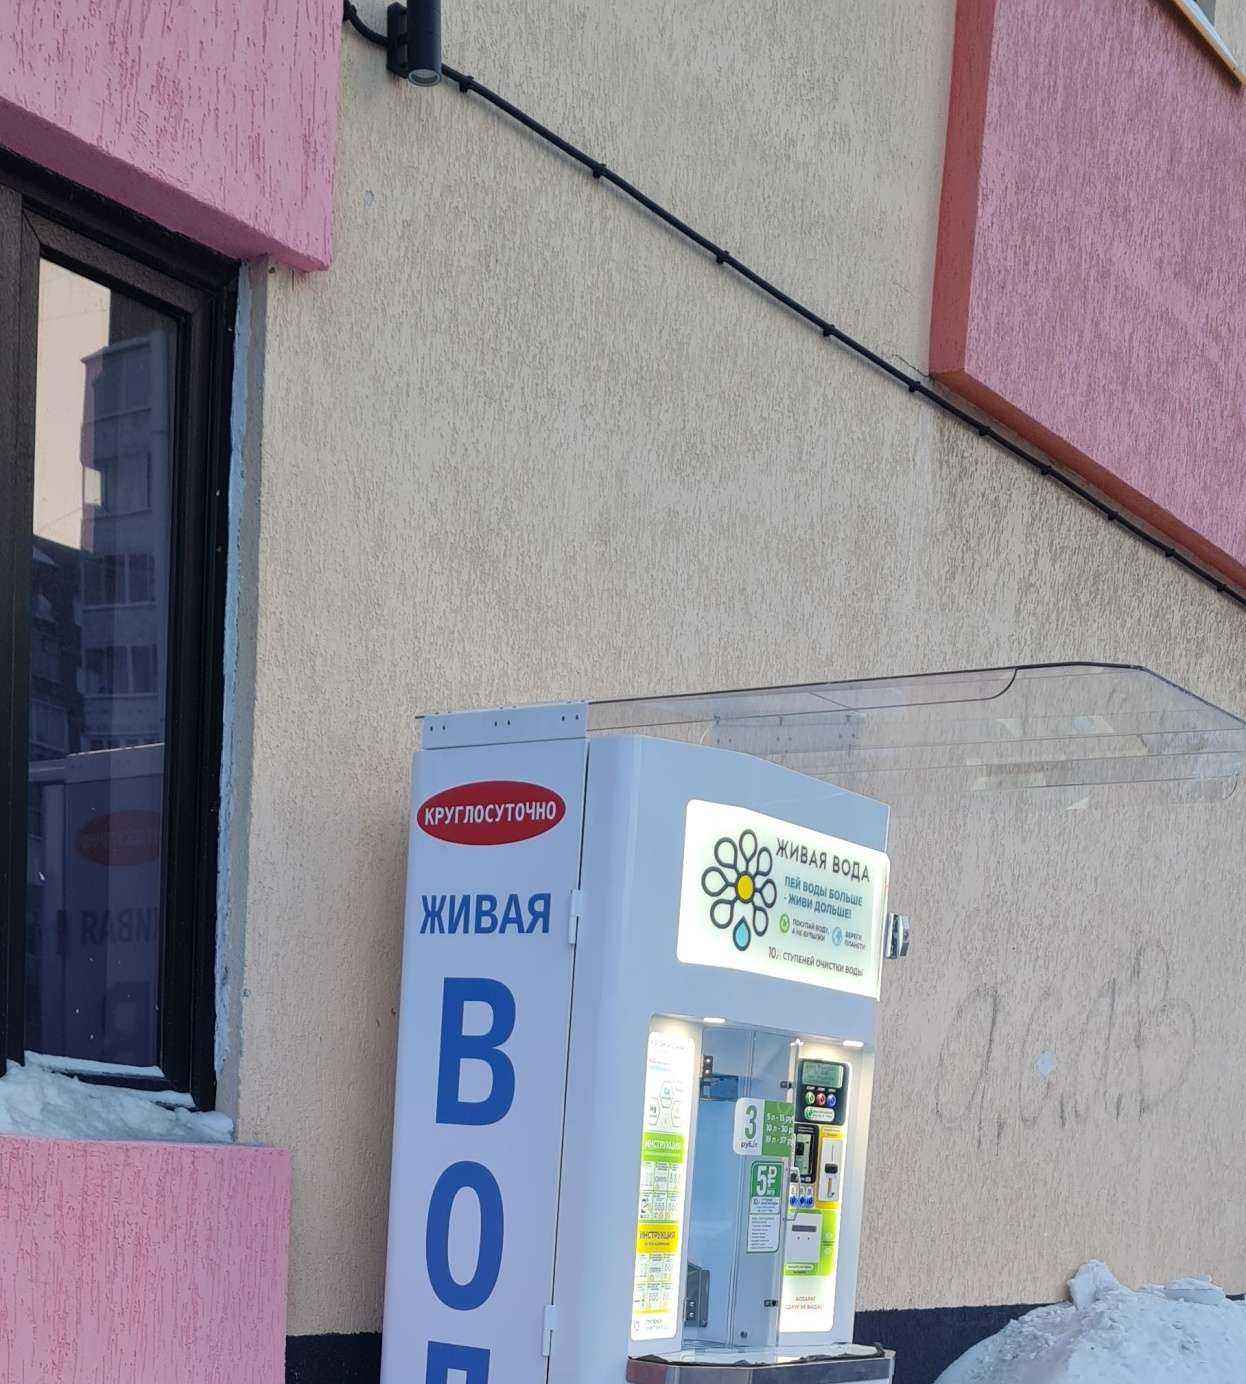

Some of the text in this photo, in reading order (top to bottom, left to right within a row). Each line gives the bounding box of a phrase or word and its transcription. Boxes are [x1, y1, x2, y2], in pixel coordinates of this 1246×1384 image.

[424, 801, 557, 826] КРУГЛОСУТОЧНО
[776, 838, 870, 883] ЖИВАЯ ВОДА
[785, 875, 863, 906] ПЕЙ ВОДЫ БОЛЬШЕ
[788, 893, 813, 909] ЖИВИ
[814, 898, 852, 918] ДОЛЬШЕ!
[419, 892, 552, 935] ЖИВАЯ
[782, 951, 815, 967] СТУПЕНЕЙ
[815, 958, 845, 974] ОЧИСТКИ
[845, 965, 864, 977] ВОДЫ
[744, 1104, 757, 1140] 3
